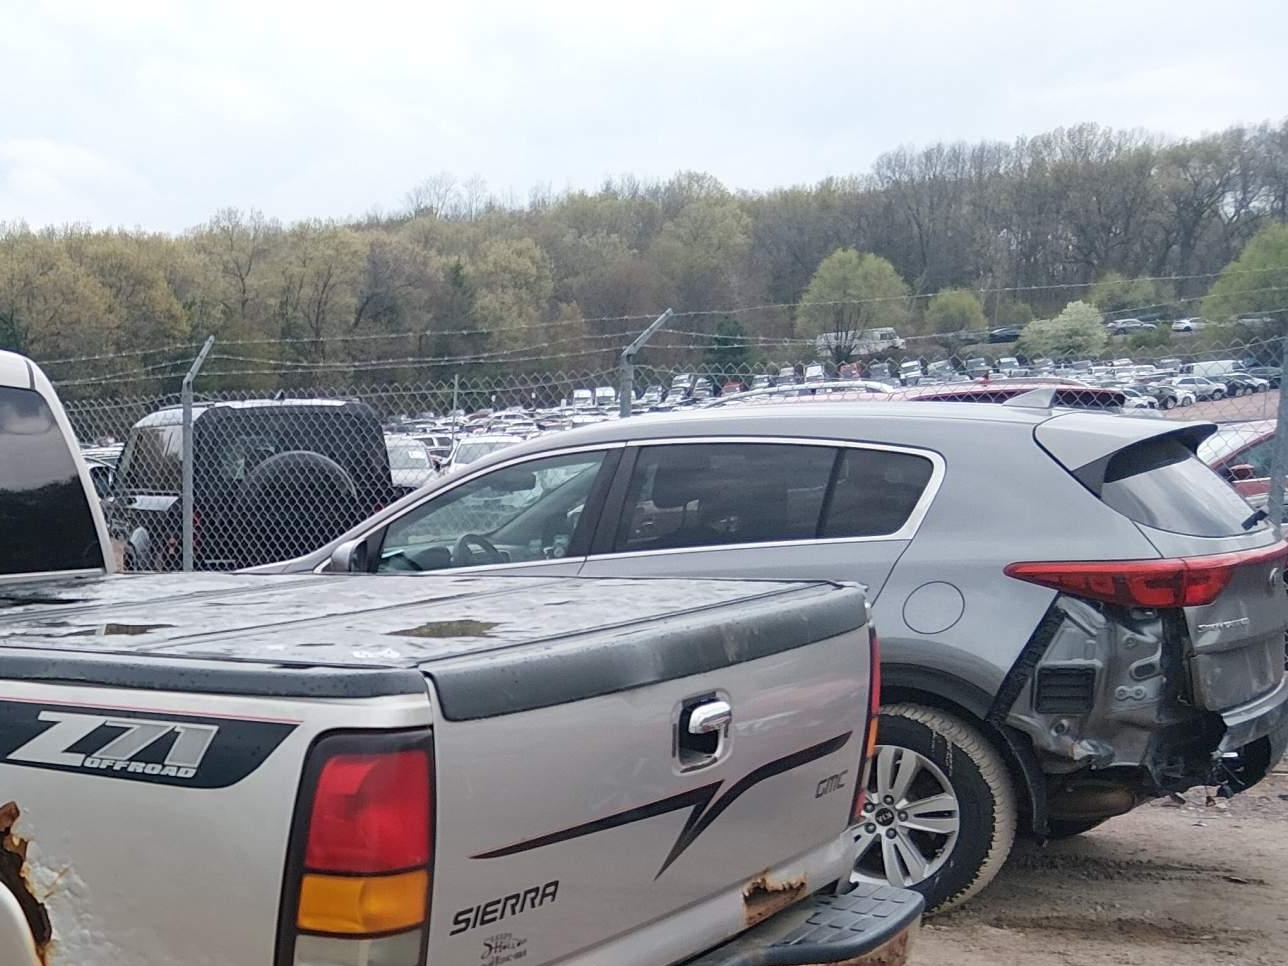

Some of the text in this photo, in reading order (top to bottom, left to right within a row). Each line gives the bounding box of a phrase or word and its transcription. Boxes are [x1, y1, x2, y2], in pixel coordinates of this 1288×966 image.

[83, 756, 198, 779] OFFROAD
[815, 769, 848, 798] GMC
[449, 880, 560, 936] SIERRA
